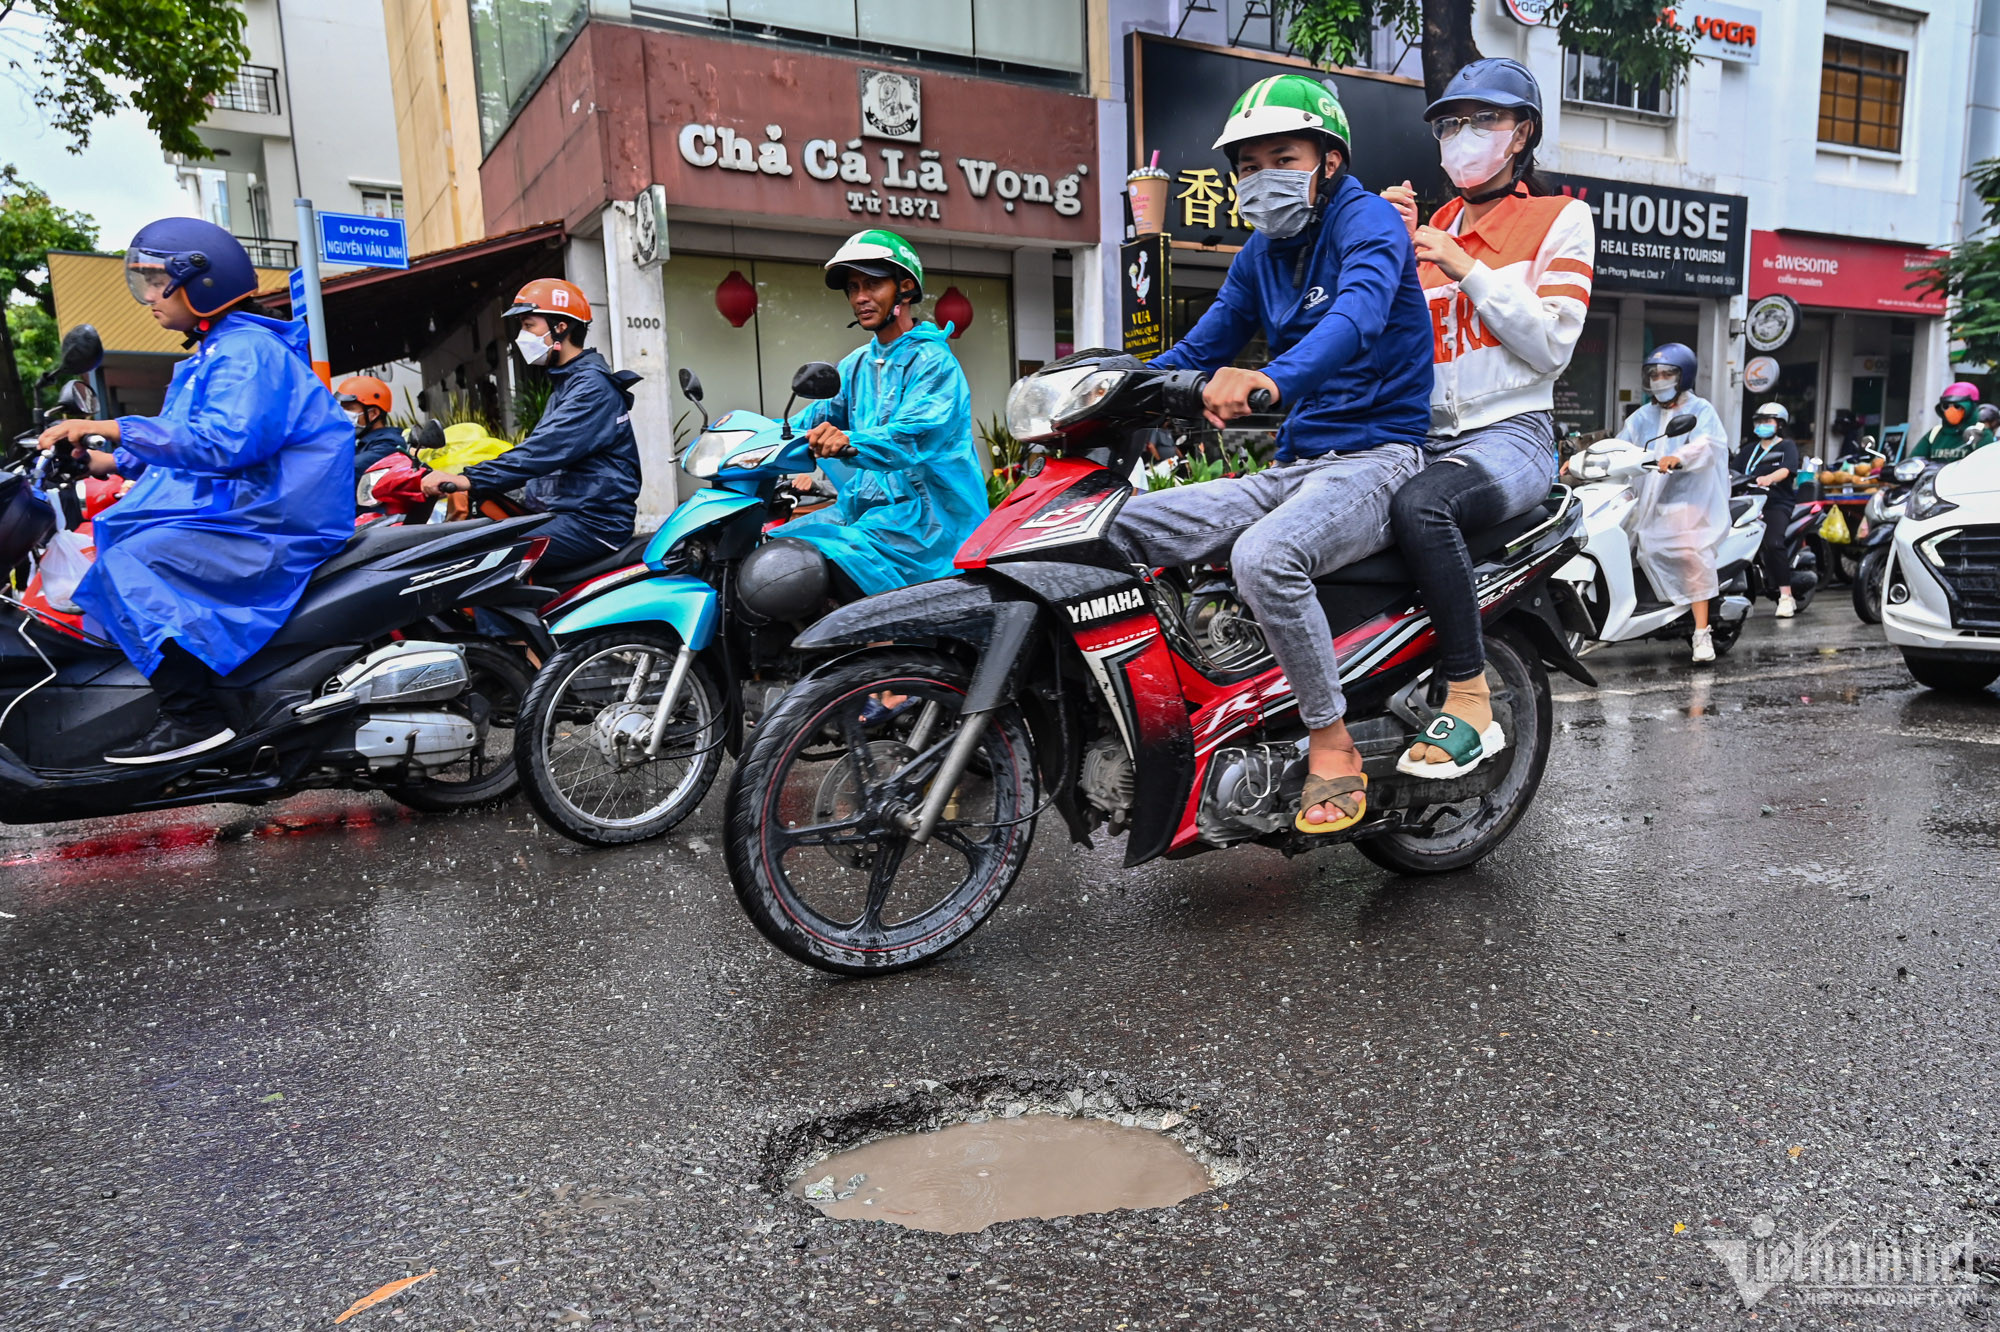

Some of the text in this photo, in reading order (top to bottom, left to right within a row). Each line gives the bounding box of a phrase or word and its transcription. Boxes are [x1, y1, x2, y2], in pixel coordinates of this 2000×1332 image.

[1696, 14, 1756, 47] YOGA
[679, 123, 1083, 216] Chả Cá Lã Vọng
[847, 190, 941, 220] Từ 1871
[340, 225, 389, 237] ĐƯỜNG
[384, 246, 403, 259] LINH
[1601, 239, 1726, 264] REAL ESTATE & TOURISM
[1608, 266, 1628, 279] Phong
[1763, 254, 1839, 275] the awesome
[1777, 274, 1797, 285] coffee
[627, 317, 661, 330] 1000
[1131, 310, 1152, 325] VUA
[1066, 588, 1145, 623] YAMAHA
[1086, 627, 1157, 651] RC-EDITION
[1425, 715, 1456, 740] C
